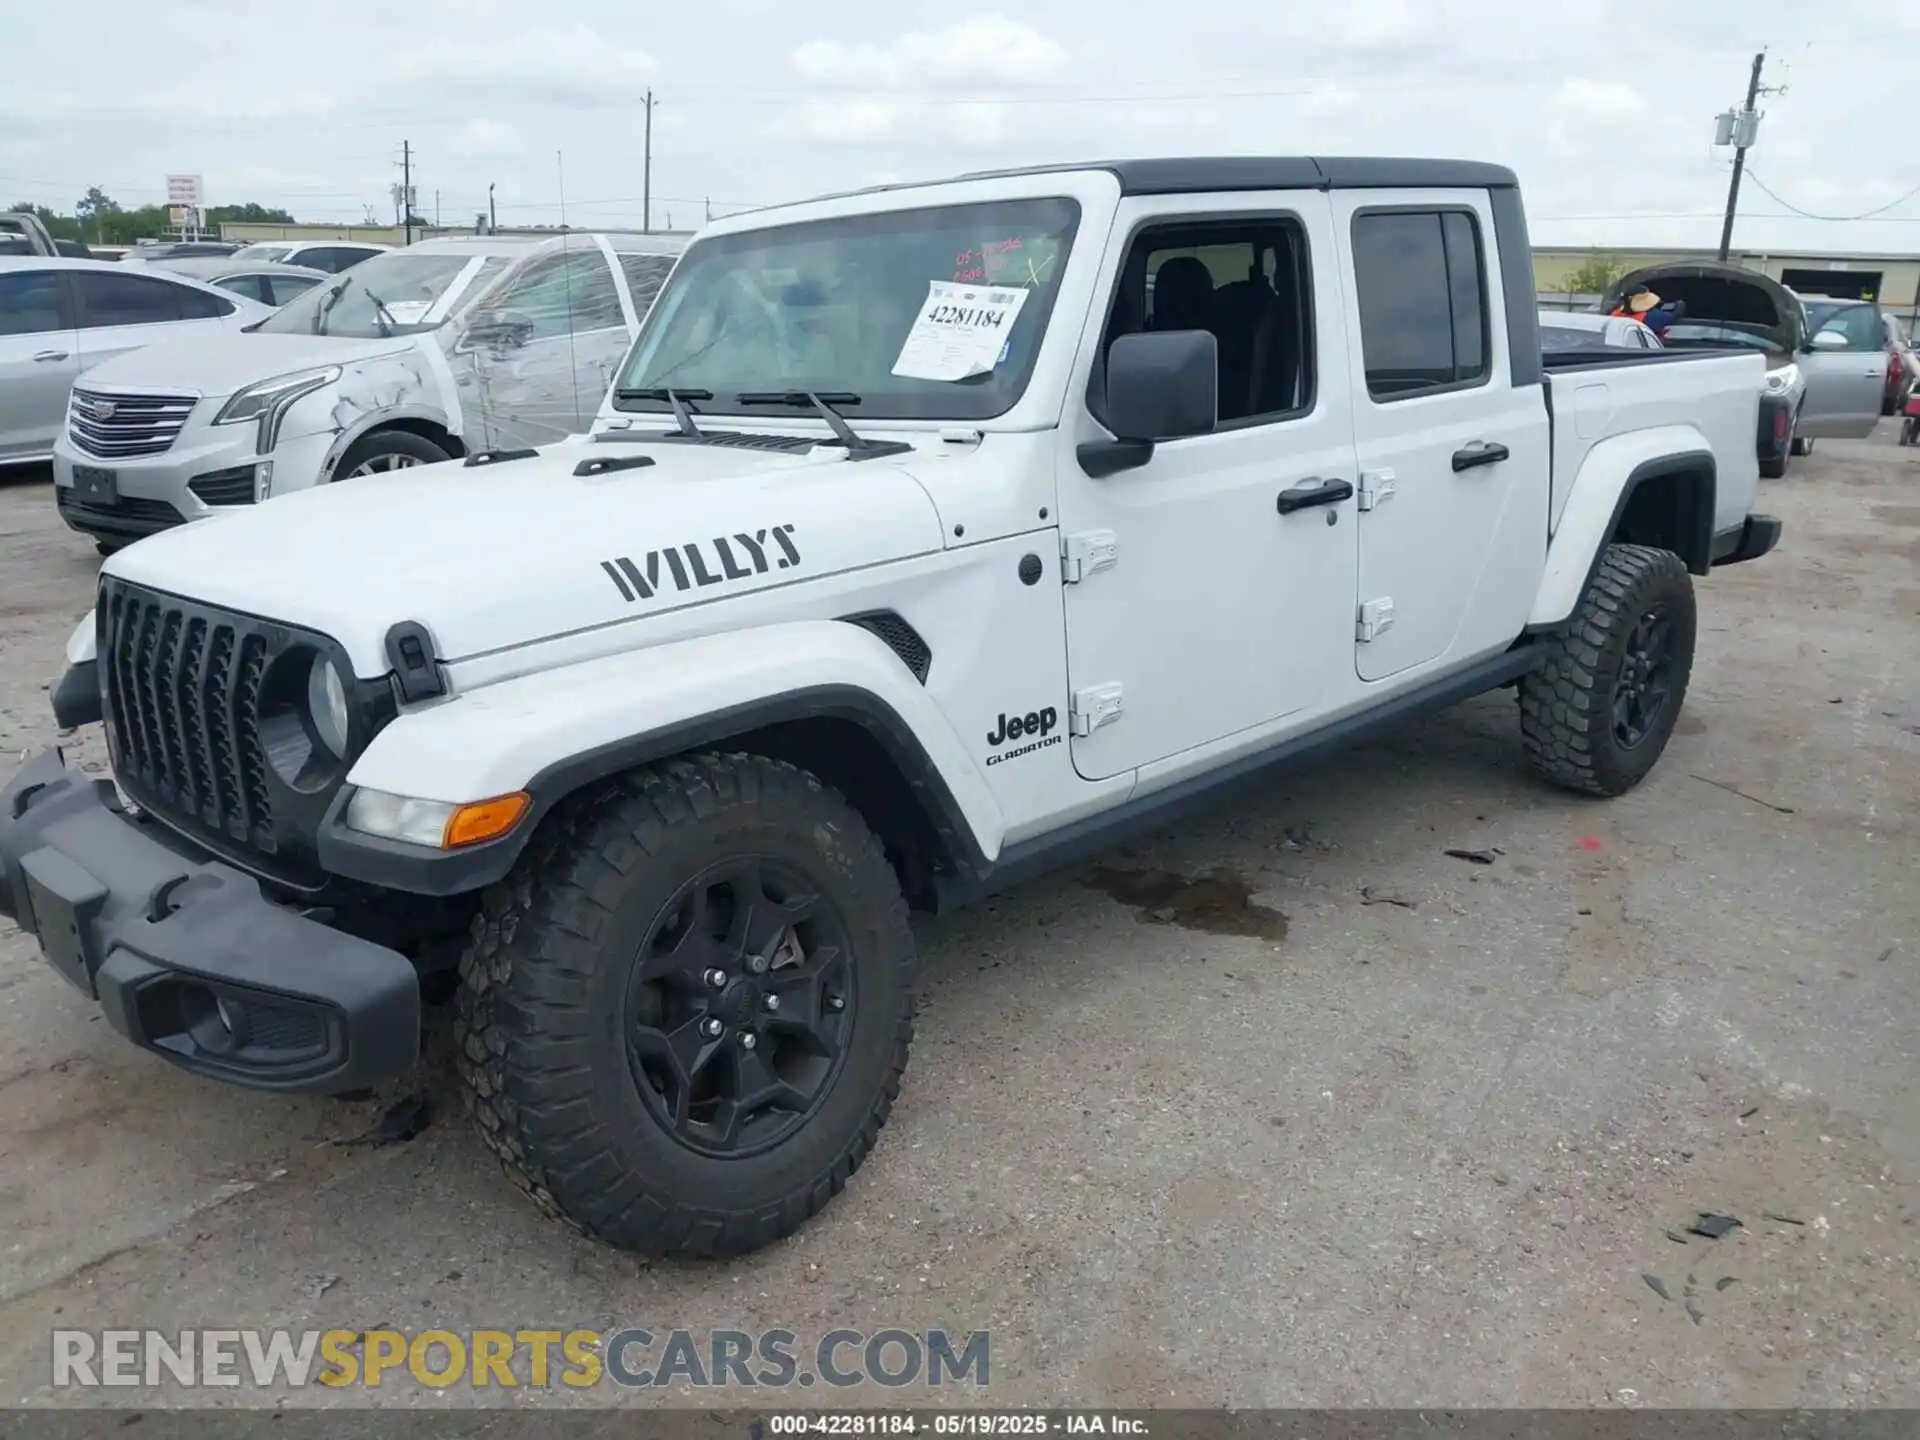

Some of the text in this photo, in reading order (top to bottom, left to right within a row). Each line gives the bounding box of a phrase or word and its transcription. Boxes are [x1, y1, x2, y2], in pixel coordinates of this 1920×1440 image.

[928, 305, 1005, 328] 42281184
[599, 523, 801, 602] WILLYS
[986, 705, 1057, 746] Jeep
[985, 735, 1062, 767] GLADIATOR
